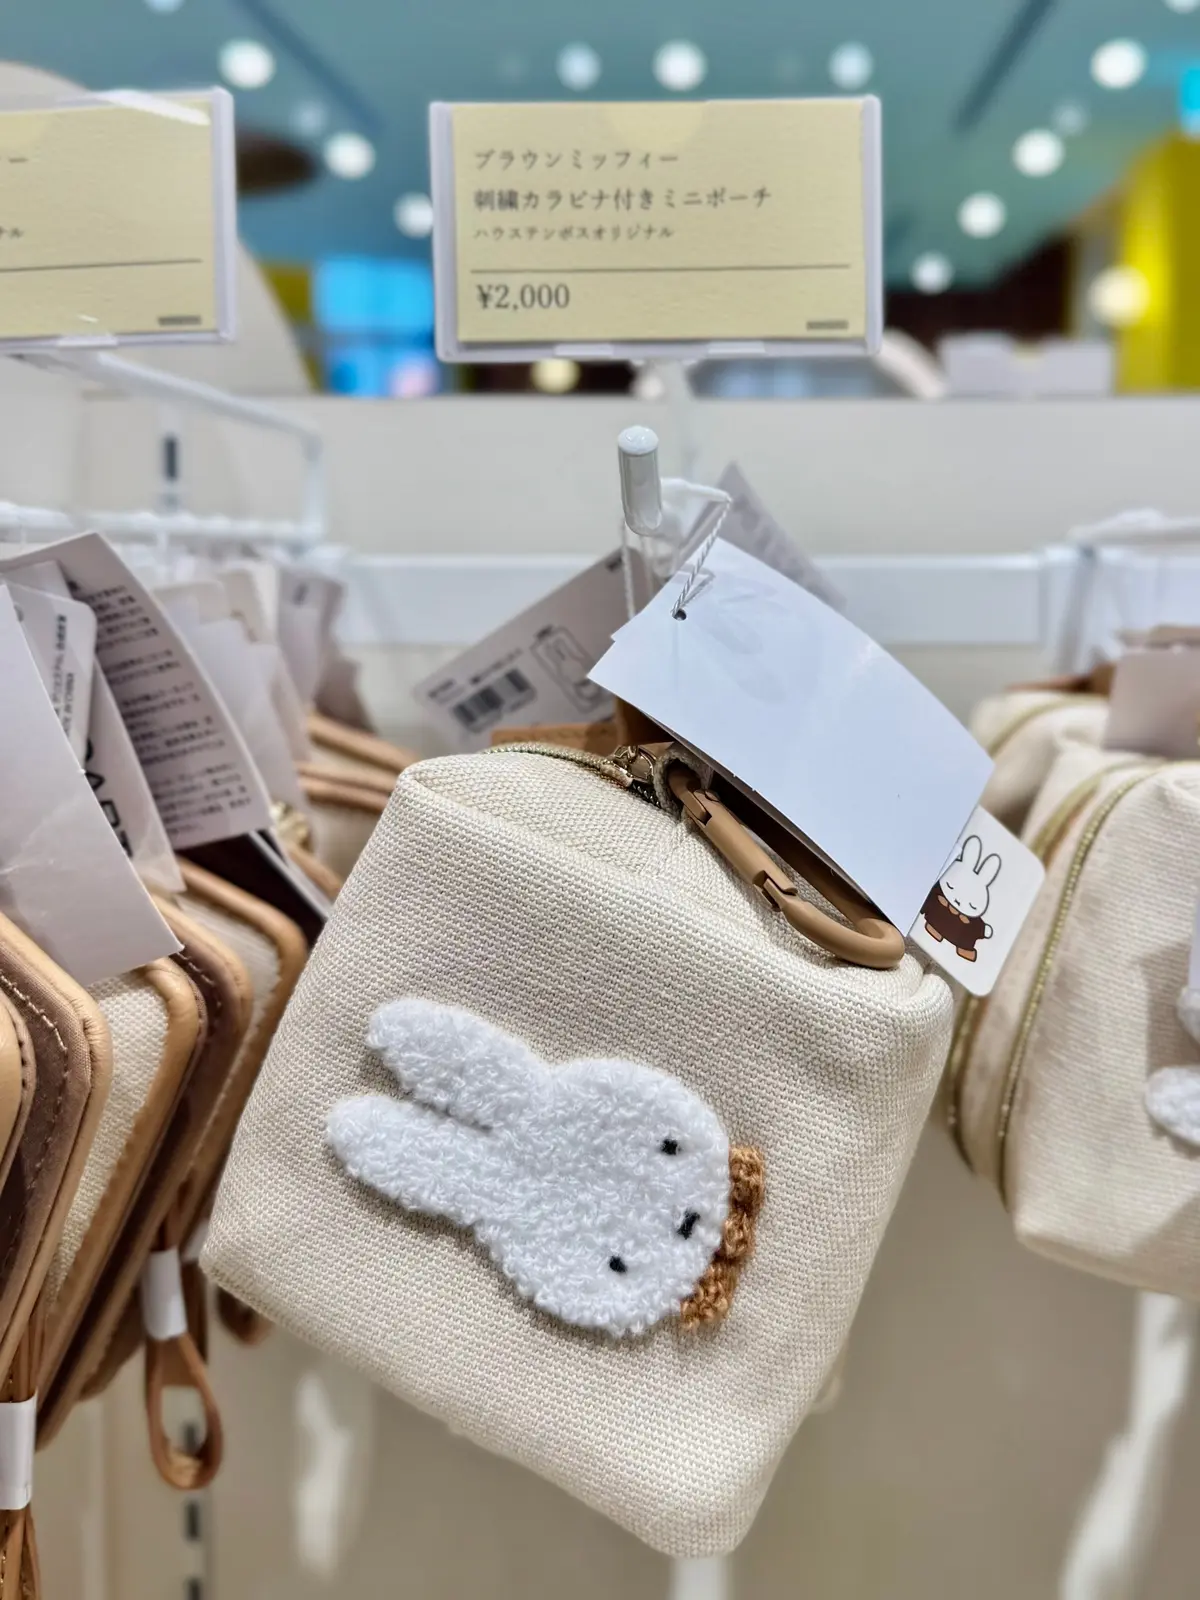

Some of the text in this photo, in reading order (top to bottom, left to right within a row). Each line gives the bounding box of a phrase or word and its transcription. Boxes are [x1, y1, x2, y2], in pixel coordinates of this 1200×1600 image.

[474, 148, 679, 171] ブラウンミッフィー
[477, 283, 570, 311] ¥2,000
